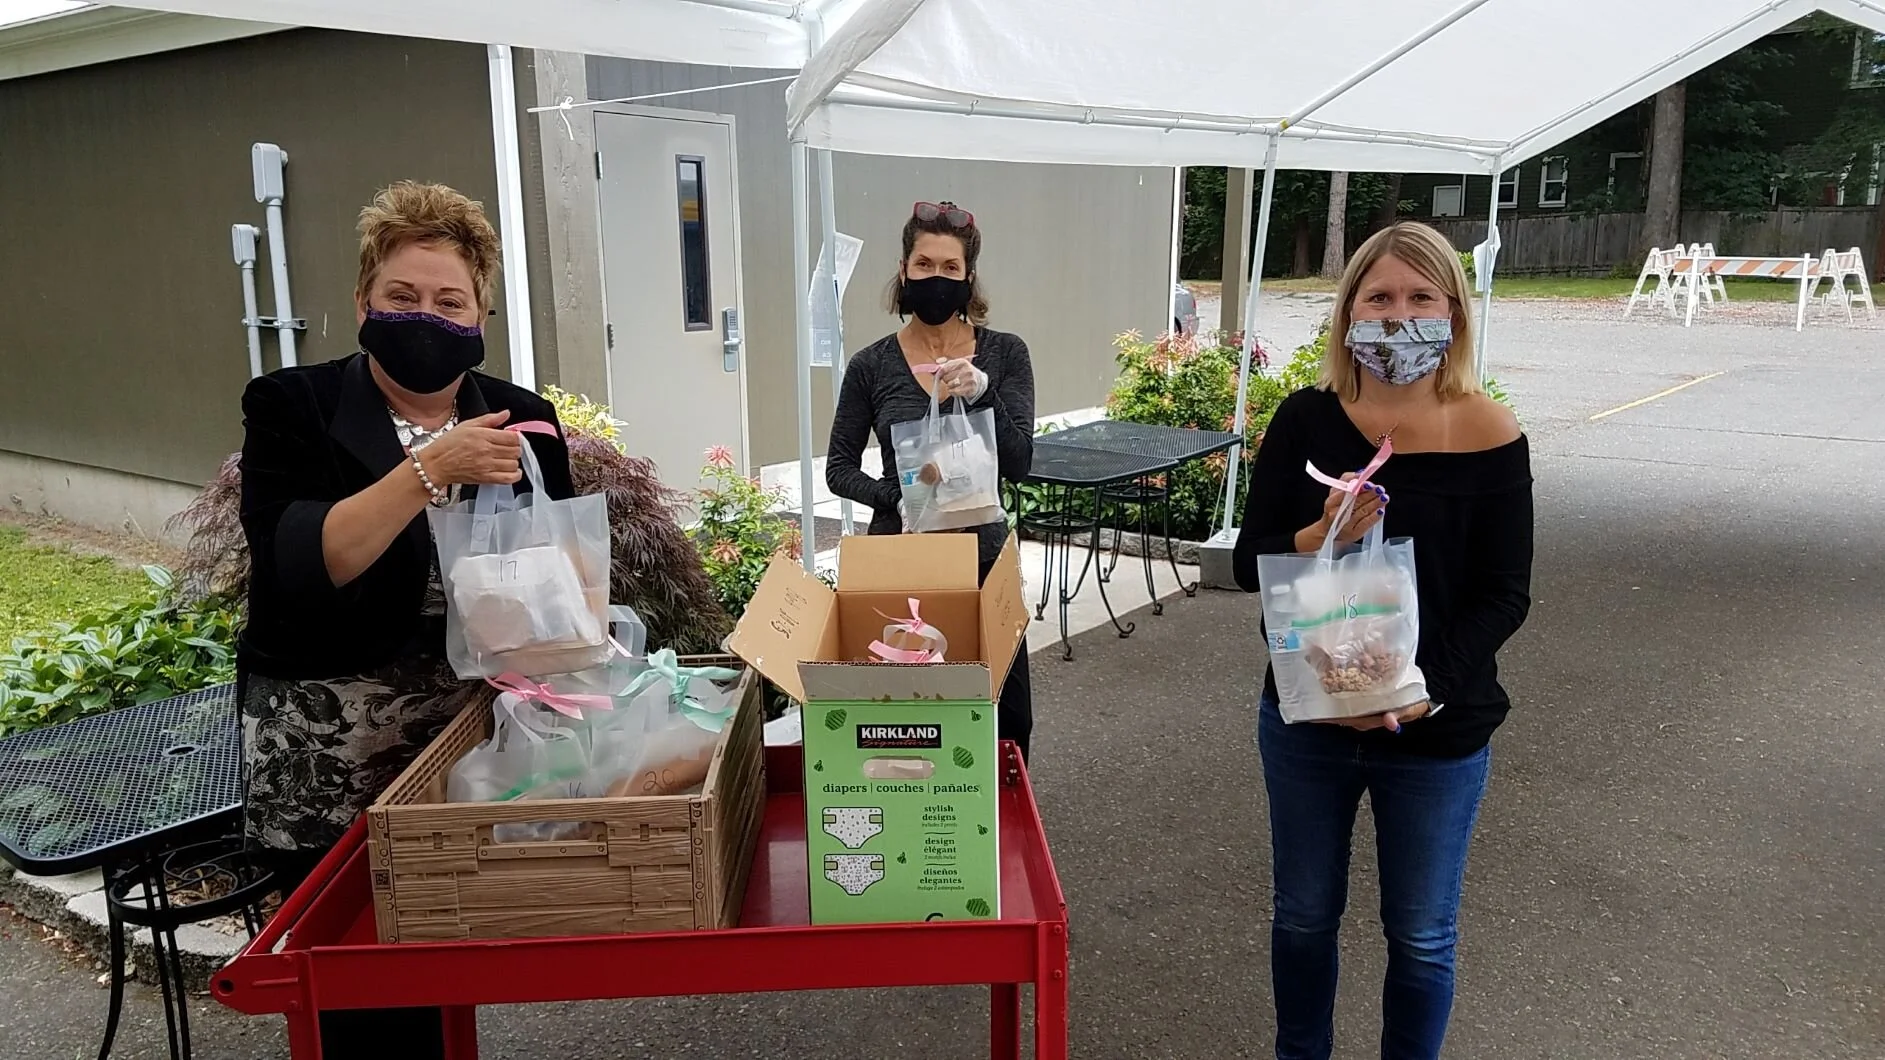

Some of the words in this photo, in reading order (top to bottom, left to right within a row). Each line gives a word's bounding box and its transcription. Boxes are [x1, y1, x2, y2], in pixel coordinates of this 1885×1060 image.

[499, 559, 519, 582] 17
[1342, 593, 1358, 620] 18
[861, 727, 938, 739] KIRKLAND
[862, 738, 938, 748] Signature
[822, 783, 868, 795] diapers
[876, 783, 925, 794] couches
[933, 783, 979, 795] pañales
[924, 804, 954, 814] stylish
[921, 813, 957, 823] designs
[924, 837, 955, 847] design
[923, 846, 956, 855] élégant
[923, 868, 958, 876] diseños
[919, 877, 962, 886] elegantes
